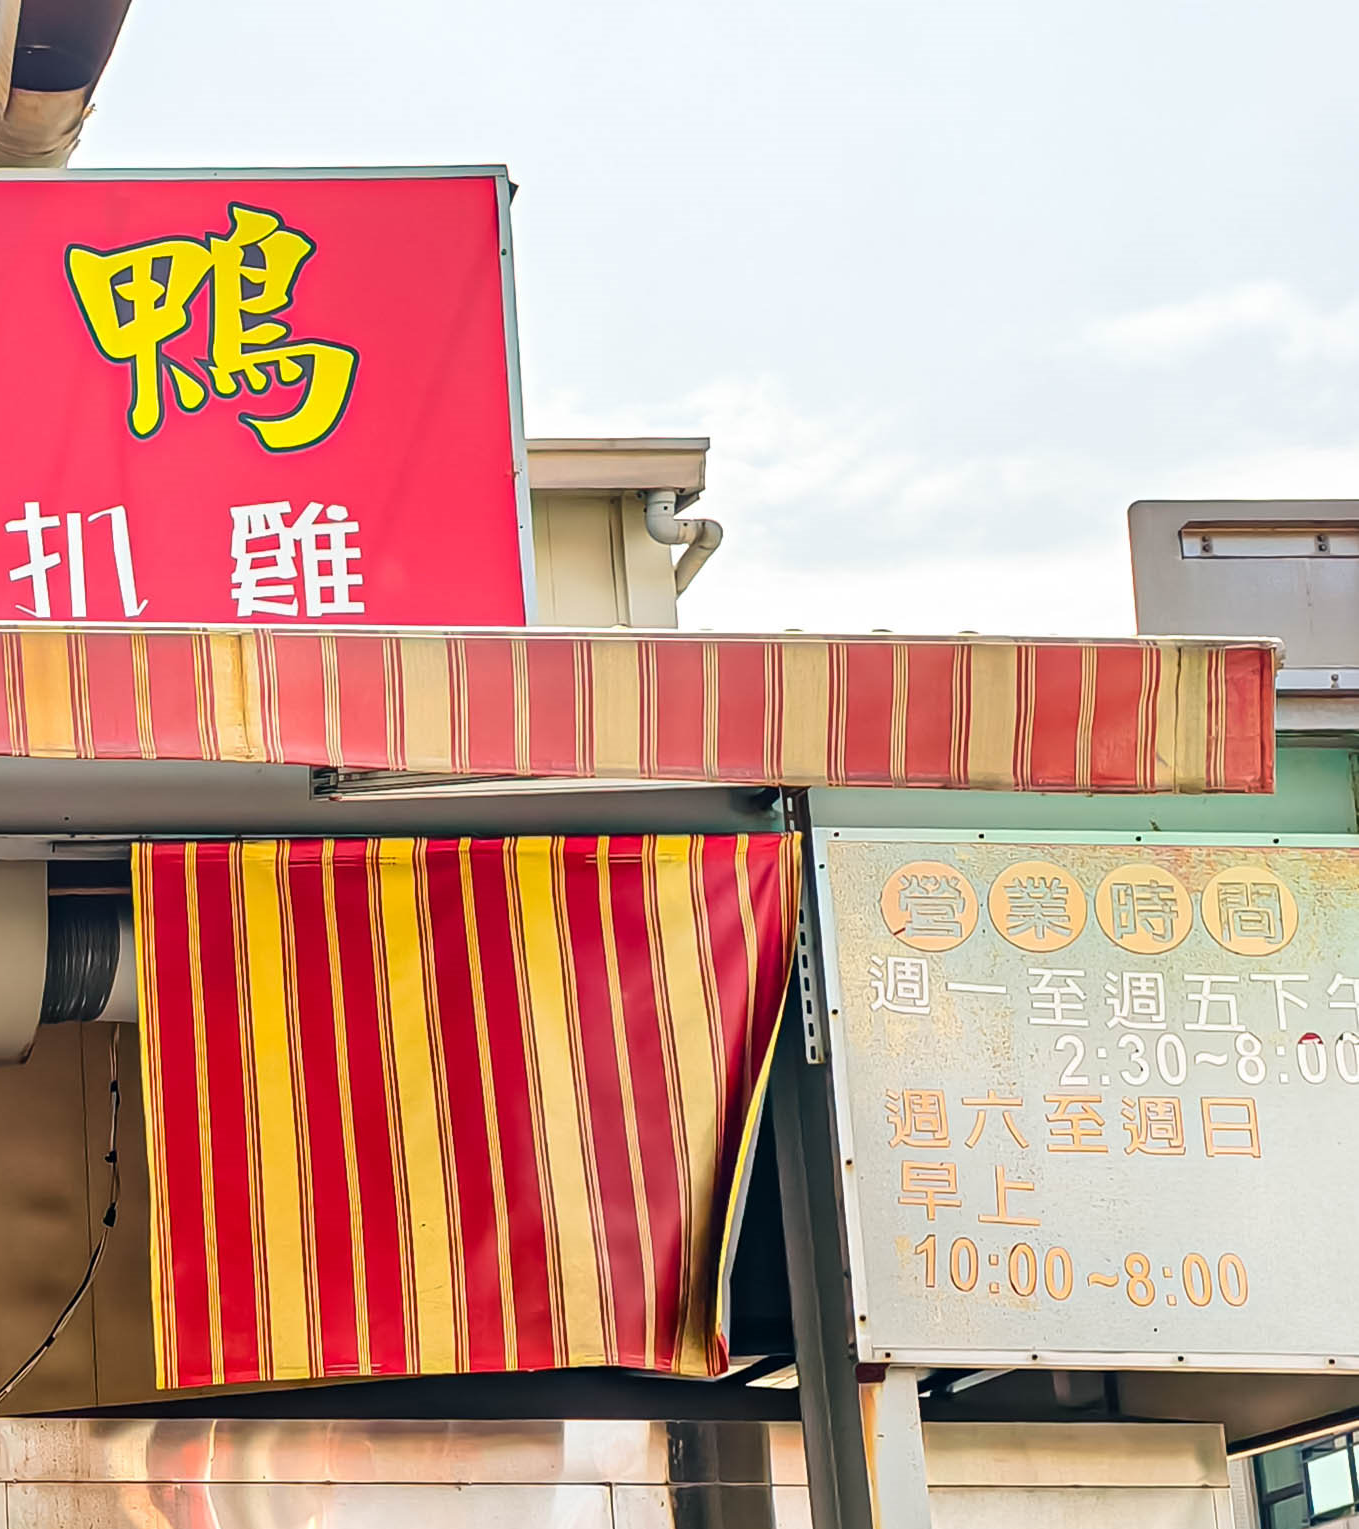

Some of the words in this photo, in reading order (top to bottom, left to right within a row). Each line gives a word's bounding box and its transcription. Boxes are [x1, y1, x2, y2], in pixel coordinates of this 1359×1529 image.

[896, 872, 1285, 945] 營業時間
[884, 1088, 1263, 1159] 週六至週日
[897, 1160, 1042, 1228] 早上
